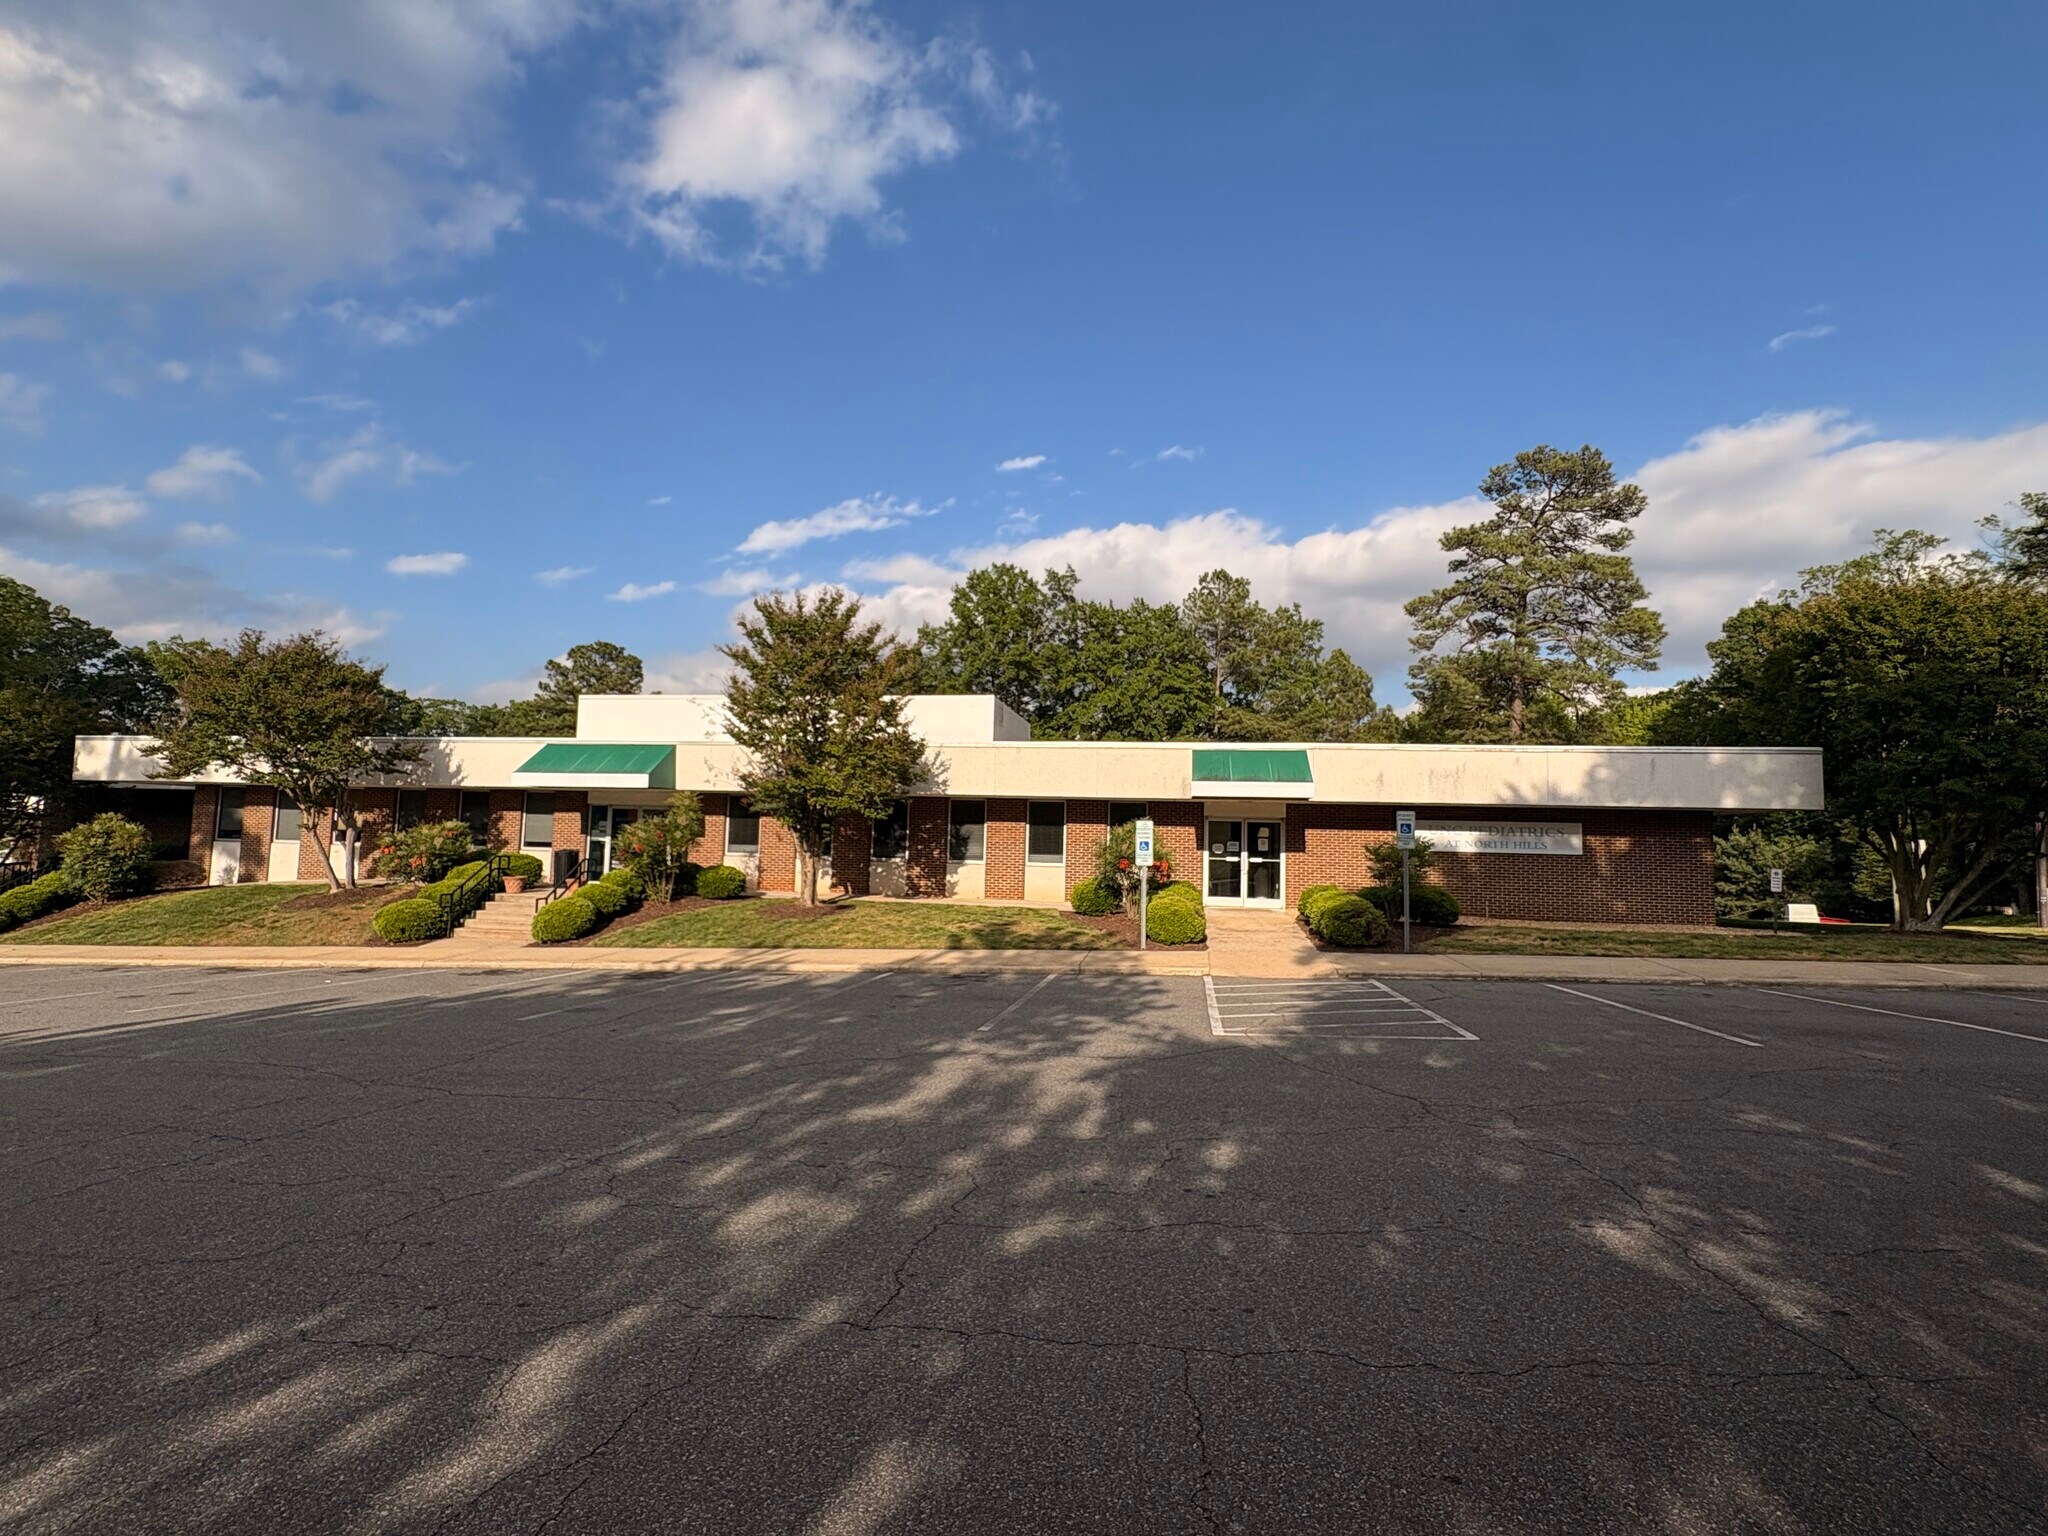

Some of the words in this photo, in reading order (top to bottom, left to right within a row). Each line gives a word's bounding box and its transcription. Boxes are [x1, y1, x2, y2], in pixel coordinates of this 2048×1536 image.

[1468, 825, 1566, 838] PEDIATRICS
[1444, 839, 1461, 848] AT
[1465, 840, 1509, 849] NORTH
[1513, 840, 1548, 850] HILLS
